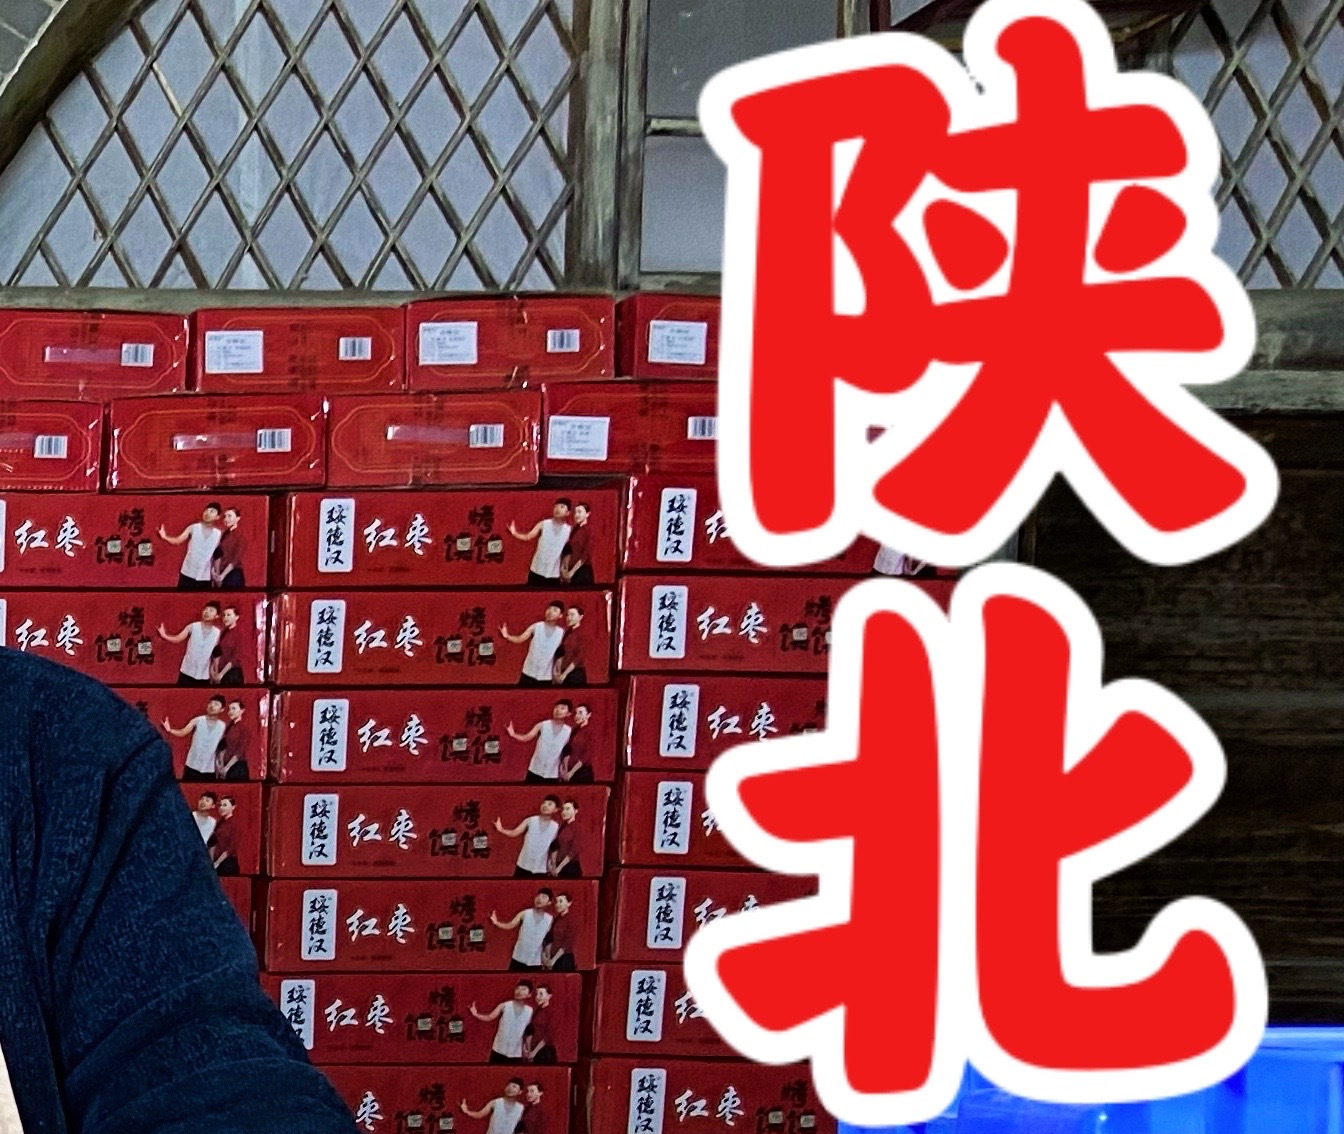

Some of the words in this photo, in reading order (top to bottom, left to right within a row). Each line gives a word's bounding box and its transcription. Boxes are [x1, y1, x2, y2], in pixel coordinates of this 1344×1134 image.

[14, 515, 84, 557] 红枣
[363, 513, 433, 556] 红枣
[15, 614, 84, 657] 红枣
[353, 615, 424, 658] 红枣
[696, 601, 769, 645] 红枣
[357, 713, 429, 756] 红枣
[707, 702, 778, 740] 红枣
[347, 808, 418, 850] 红枣
[345, 903, 416, 944] 红枣
[324, 994, 394, 1035] 红枣
[674, 1085, 745, 1127] 红枣
